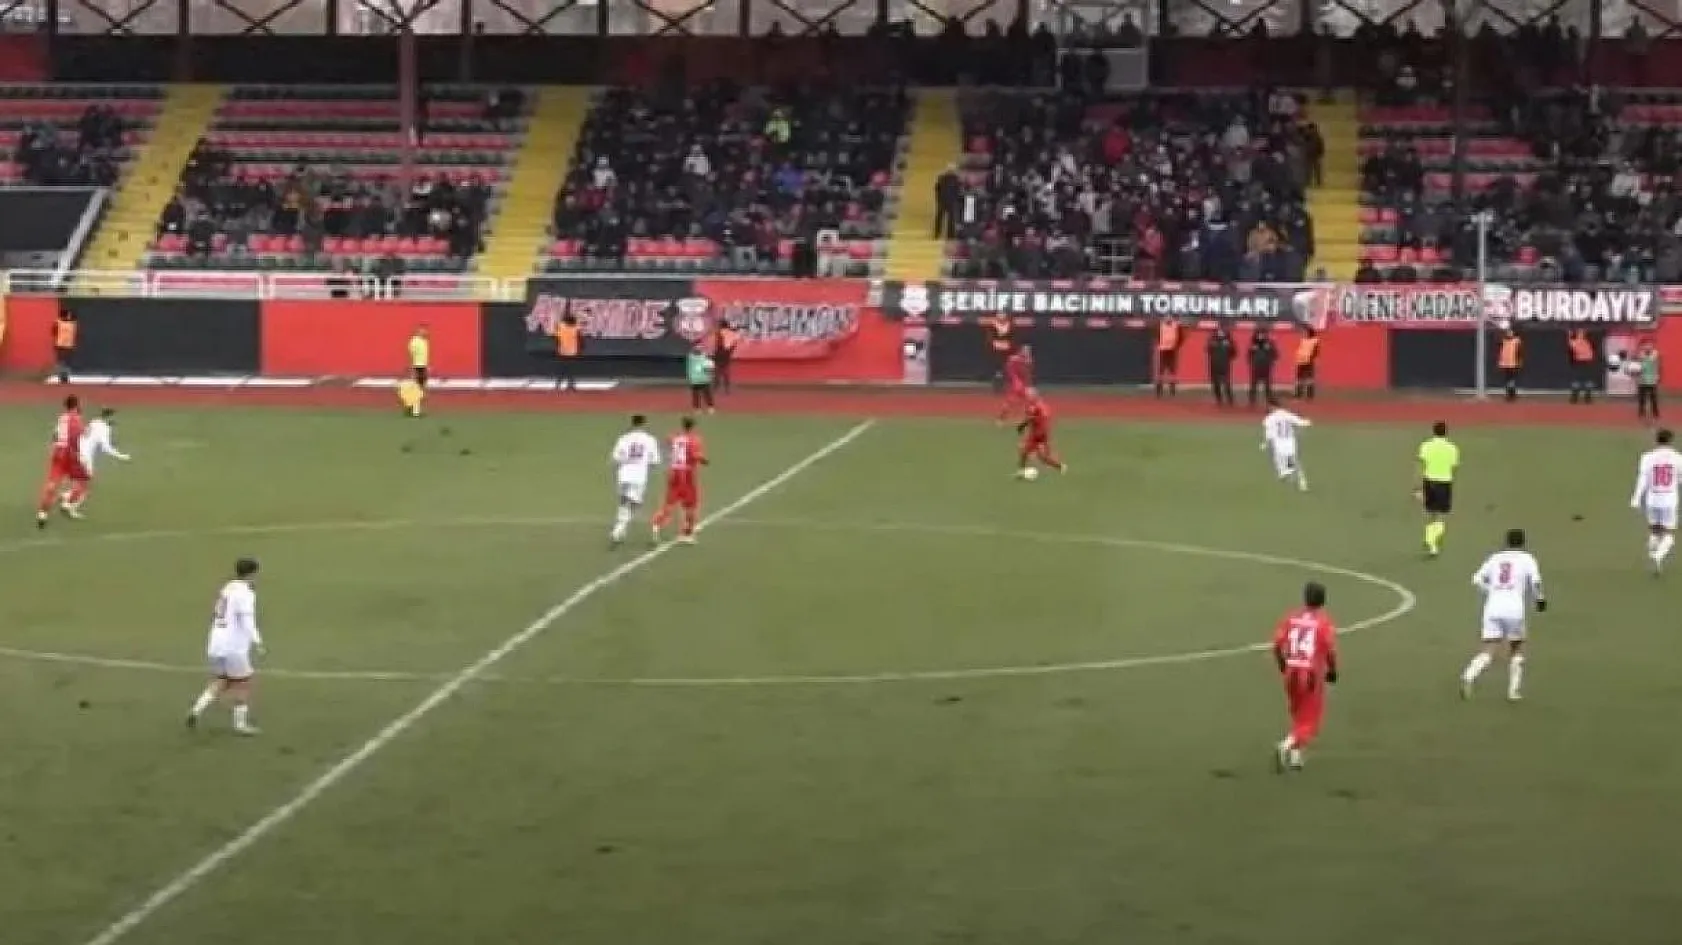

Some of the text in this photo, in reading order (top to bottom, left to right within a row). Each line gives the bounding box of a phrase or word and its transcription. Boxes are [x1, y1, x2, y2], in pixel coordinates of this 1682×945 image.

[939, 286, 1280, 318] ŞERİFE BACININ TORUNLARI
[1409, 287, 1479, 321] KADAR
[1515, 290, 1654, 322] BURDAYIZ
[1652, 463, 1674, 487] 16
[1287, 627, 1316, 658] 14
